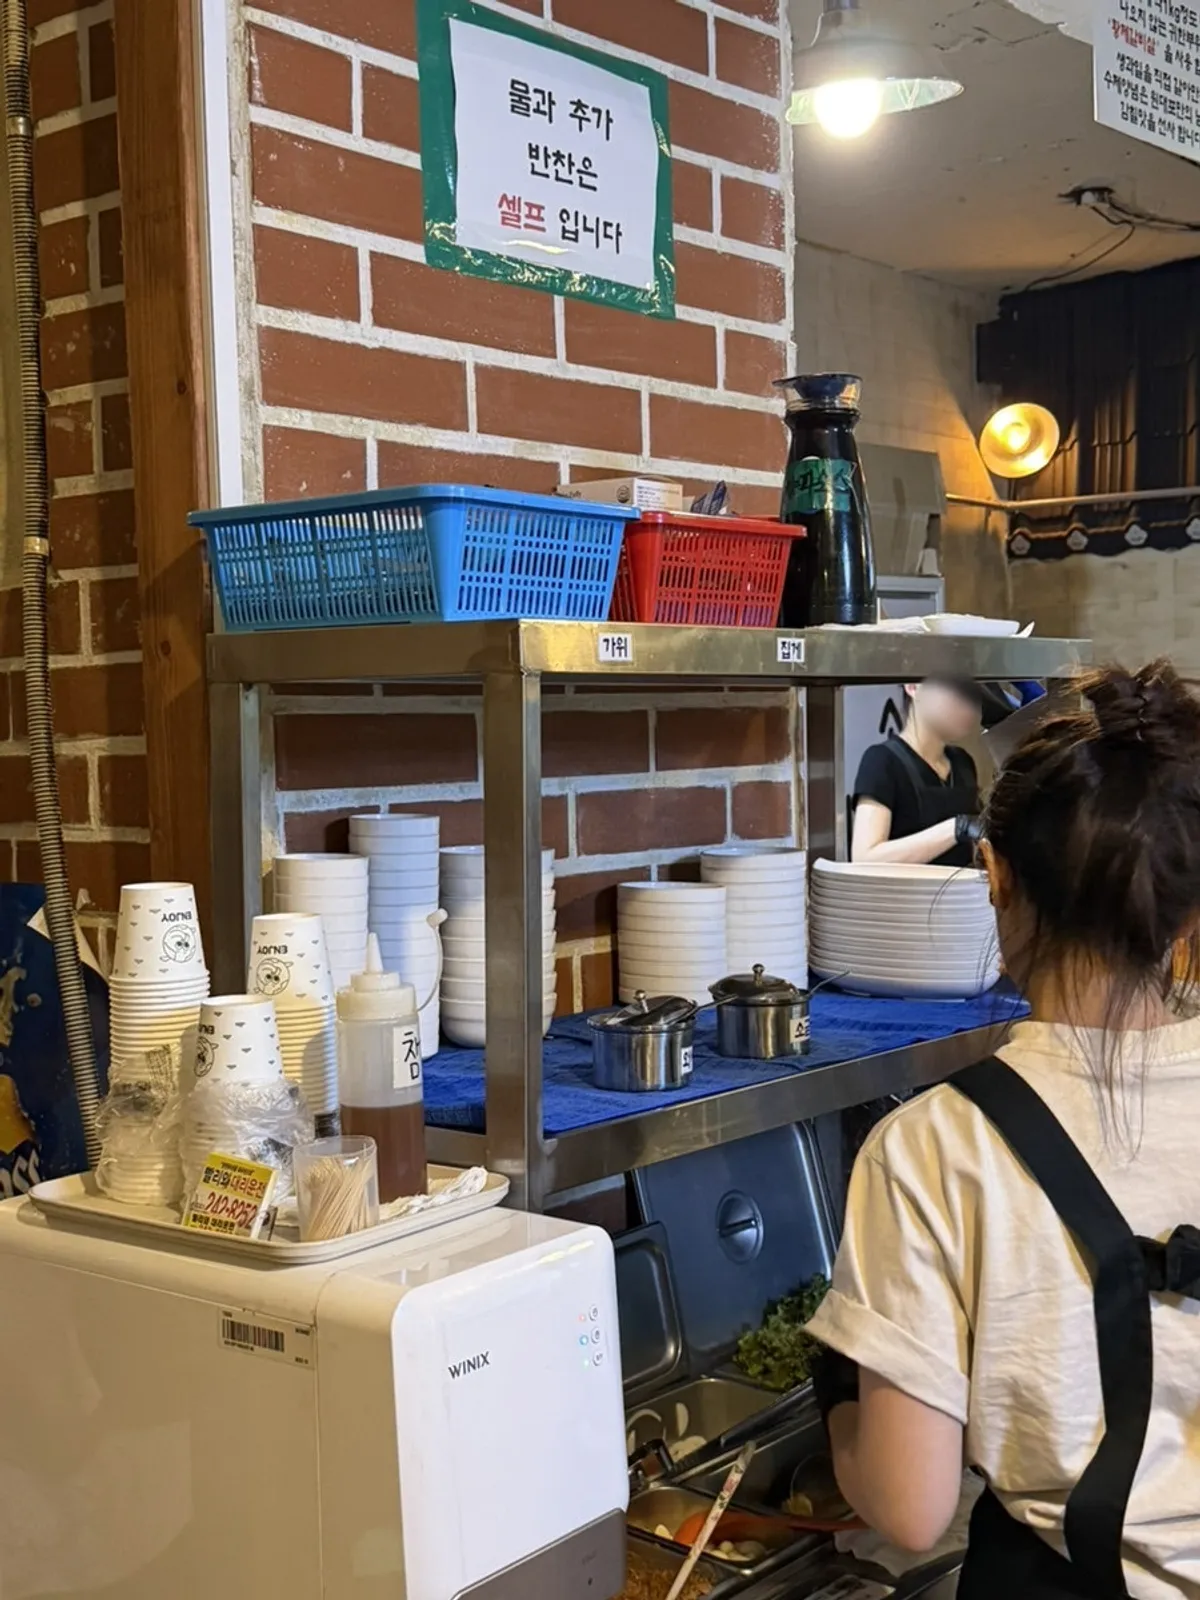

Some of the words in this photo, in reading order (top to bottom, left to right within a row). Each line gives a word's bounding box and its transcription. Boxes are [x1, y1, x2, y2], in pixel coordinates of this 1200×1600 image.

[1148, 13, 1167, 38] 않는
[1175, 49, 1193, 72] 사용
[1154, 67, 1172, 93] 직접
[508, 78, 556, 124] 물과
[569, 98, 614, 141] 추가
[1120, 101, 1156, 133] 감칠맛을
[1157, 117, 1176, 140] 선사
[527, 142, 598, 192] 반찬은
[497, 192, 547, 233] 셀프
[558, 207, 623, 255] 입니다
[602, 636, 628, 658] 가위
[161, 910, 192, 923] ENJOY
[256, 944, 288, 955] ENJOY
[448, 1351, 490, 1380] WINIX
